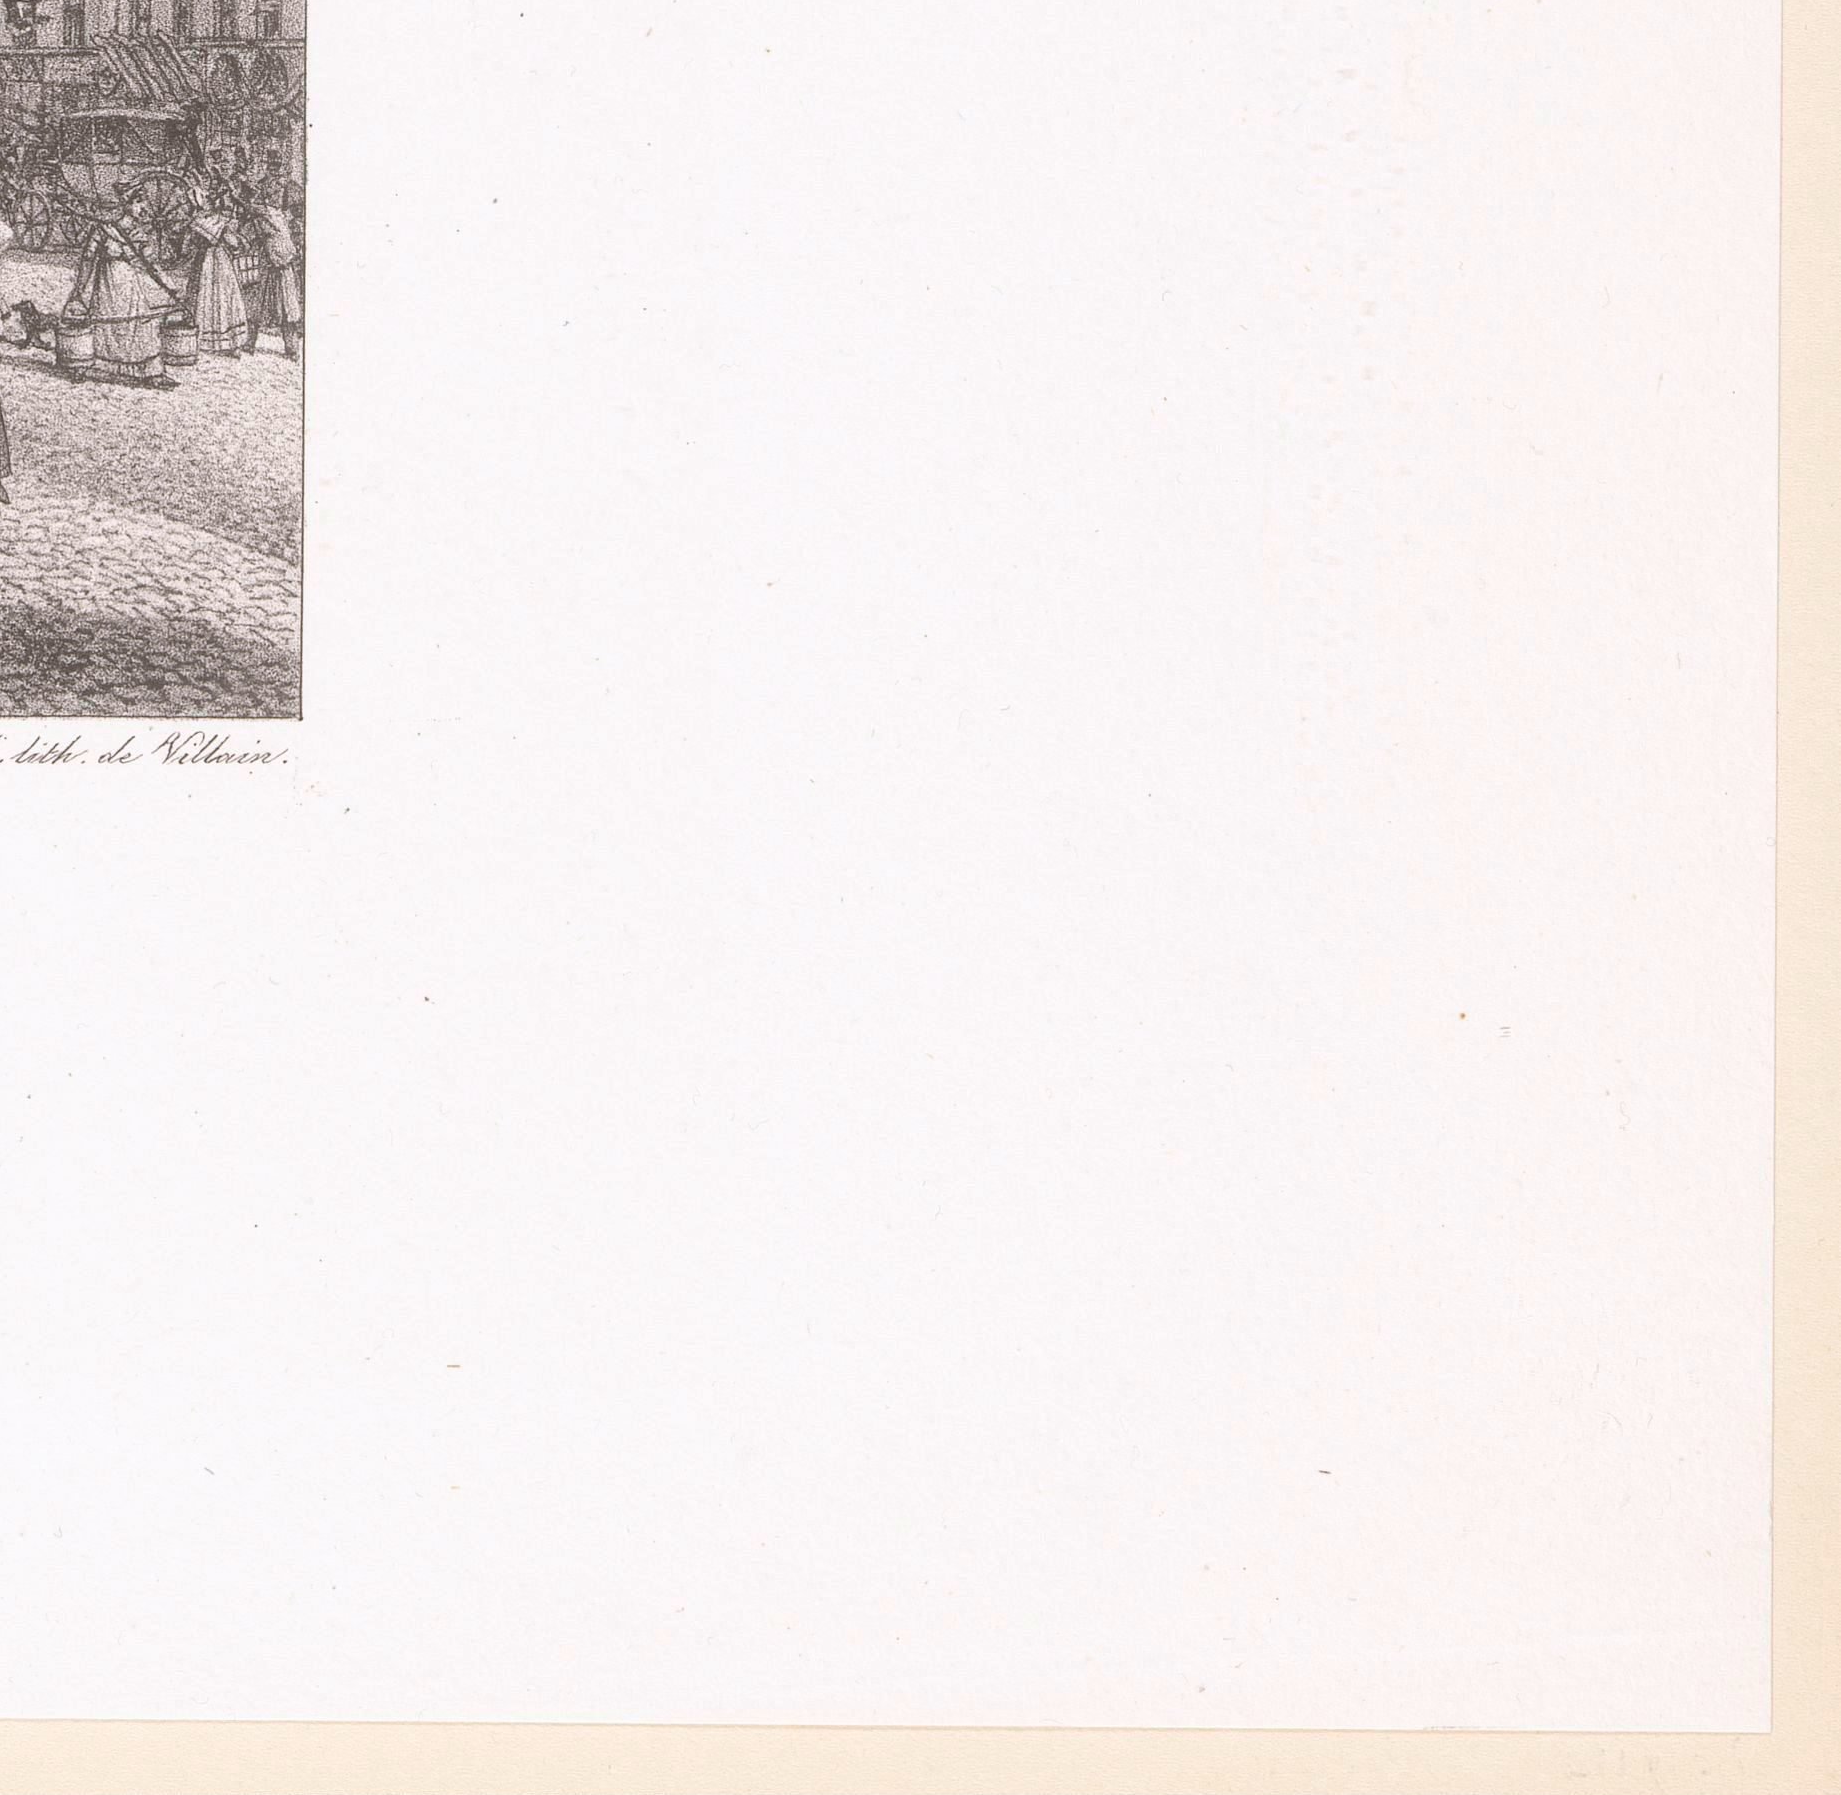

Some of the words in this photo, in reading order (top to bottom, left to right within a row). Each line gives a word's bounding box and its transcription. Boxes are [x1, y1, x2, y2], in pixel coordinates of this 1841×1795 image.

[10, 735, 87, 765] lith.
[98, 736, 143, 765] de
[151, 731, 288, 765] Villain.
